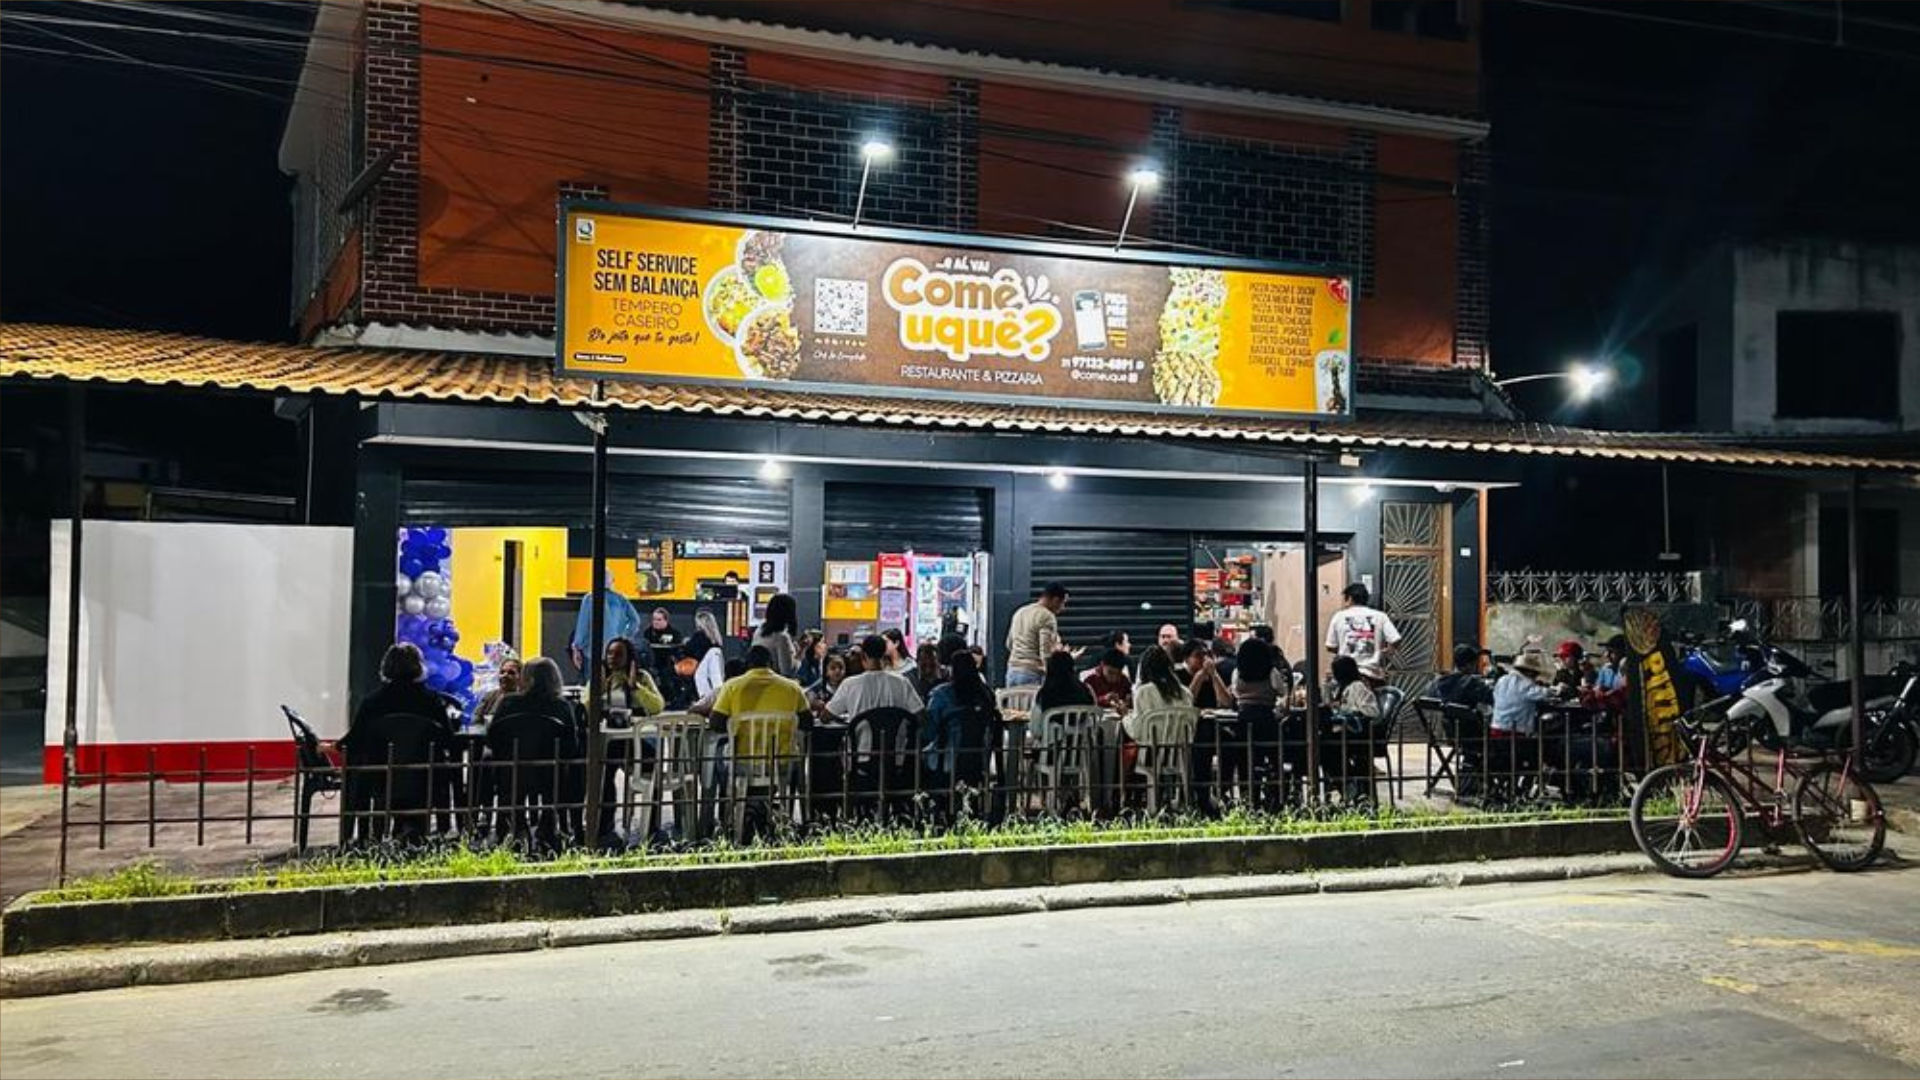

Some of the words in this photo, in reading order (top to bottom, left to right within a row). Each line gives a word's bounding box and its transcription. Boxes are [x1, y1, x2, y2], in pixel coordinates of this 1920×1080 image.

[597, 248, 633, 270] SELF
[637, 252, 698, 275] SERVICE
[970, 258, 990, 273] VAI
[593, 271, 627, 292] SEM
[631, 275, 700, 299] BALANÇA
[889, 264, 1024, 310] Comê
[613, 297, 683, 316] TEMPERO
[613, 313, 679, 331] CASEIRO
[906, 308, 1057, 356] uquê?
[900, 364, 981, 382] RESTAURANTE
[982, 370, 993, 382] &
[994, 370, 1045, 385] PIZZARIA
